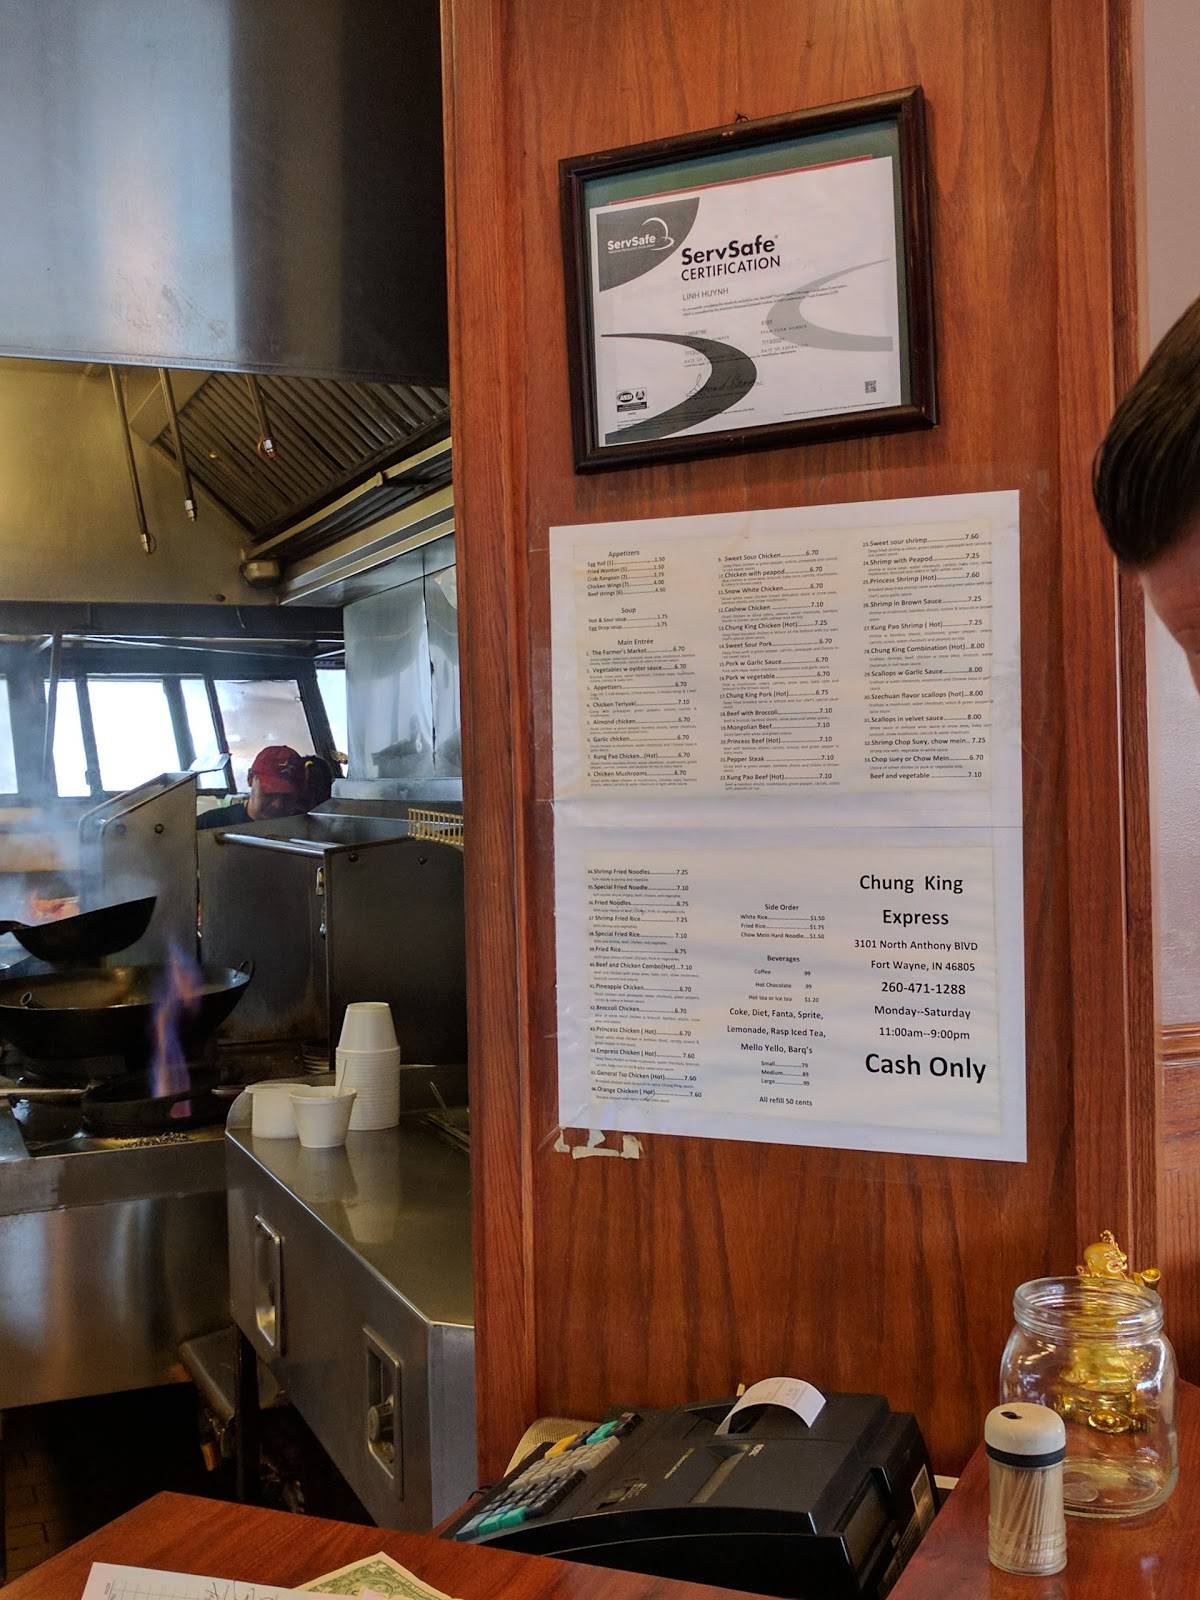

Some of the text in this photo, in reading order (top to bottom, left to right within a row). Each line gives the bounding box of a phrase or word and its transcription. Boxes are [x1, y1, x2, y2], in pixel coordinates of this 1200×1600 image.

[607, 234, 656, 250] ServSafe
[681, 235, 776, 266] ServSafe
[681, 256, 781, 281] CERTIFICATION
[682, 288, 728, 301] LINH HUYNH
[907, 644, 947, 652] Combination
[860, 875, 963, 894] Chung King
[765, 903, 779, 911] Side
[883, 909, 949, 927] Express
[854, 940, 876, 948] 3101
[880, 940, 907, 949] North
[910, 941, 951, 952] Anthony
[767, 955, 800, 963] Beverages
[871, 960, 975, 971] Fort Wayne, IN 46805
[881, 982, 966, 995] 260-471-1288
[729, 1008, 824, 1020] Coke, Diet, Fanta, Sprite,
[875, 1006, 971, 1019] Monday--Saturday
[727, 1026, 826, 1038] Lemonade, Rasp Iced Tea,
[879, 1027, 970, 1040] 11:00am--9:00pm
[741, 1043, 812, 1054] Mello Yello, Barq's
[865, 1053, 986, 1084] Cash Only
